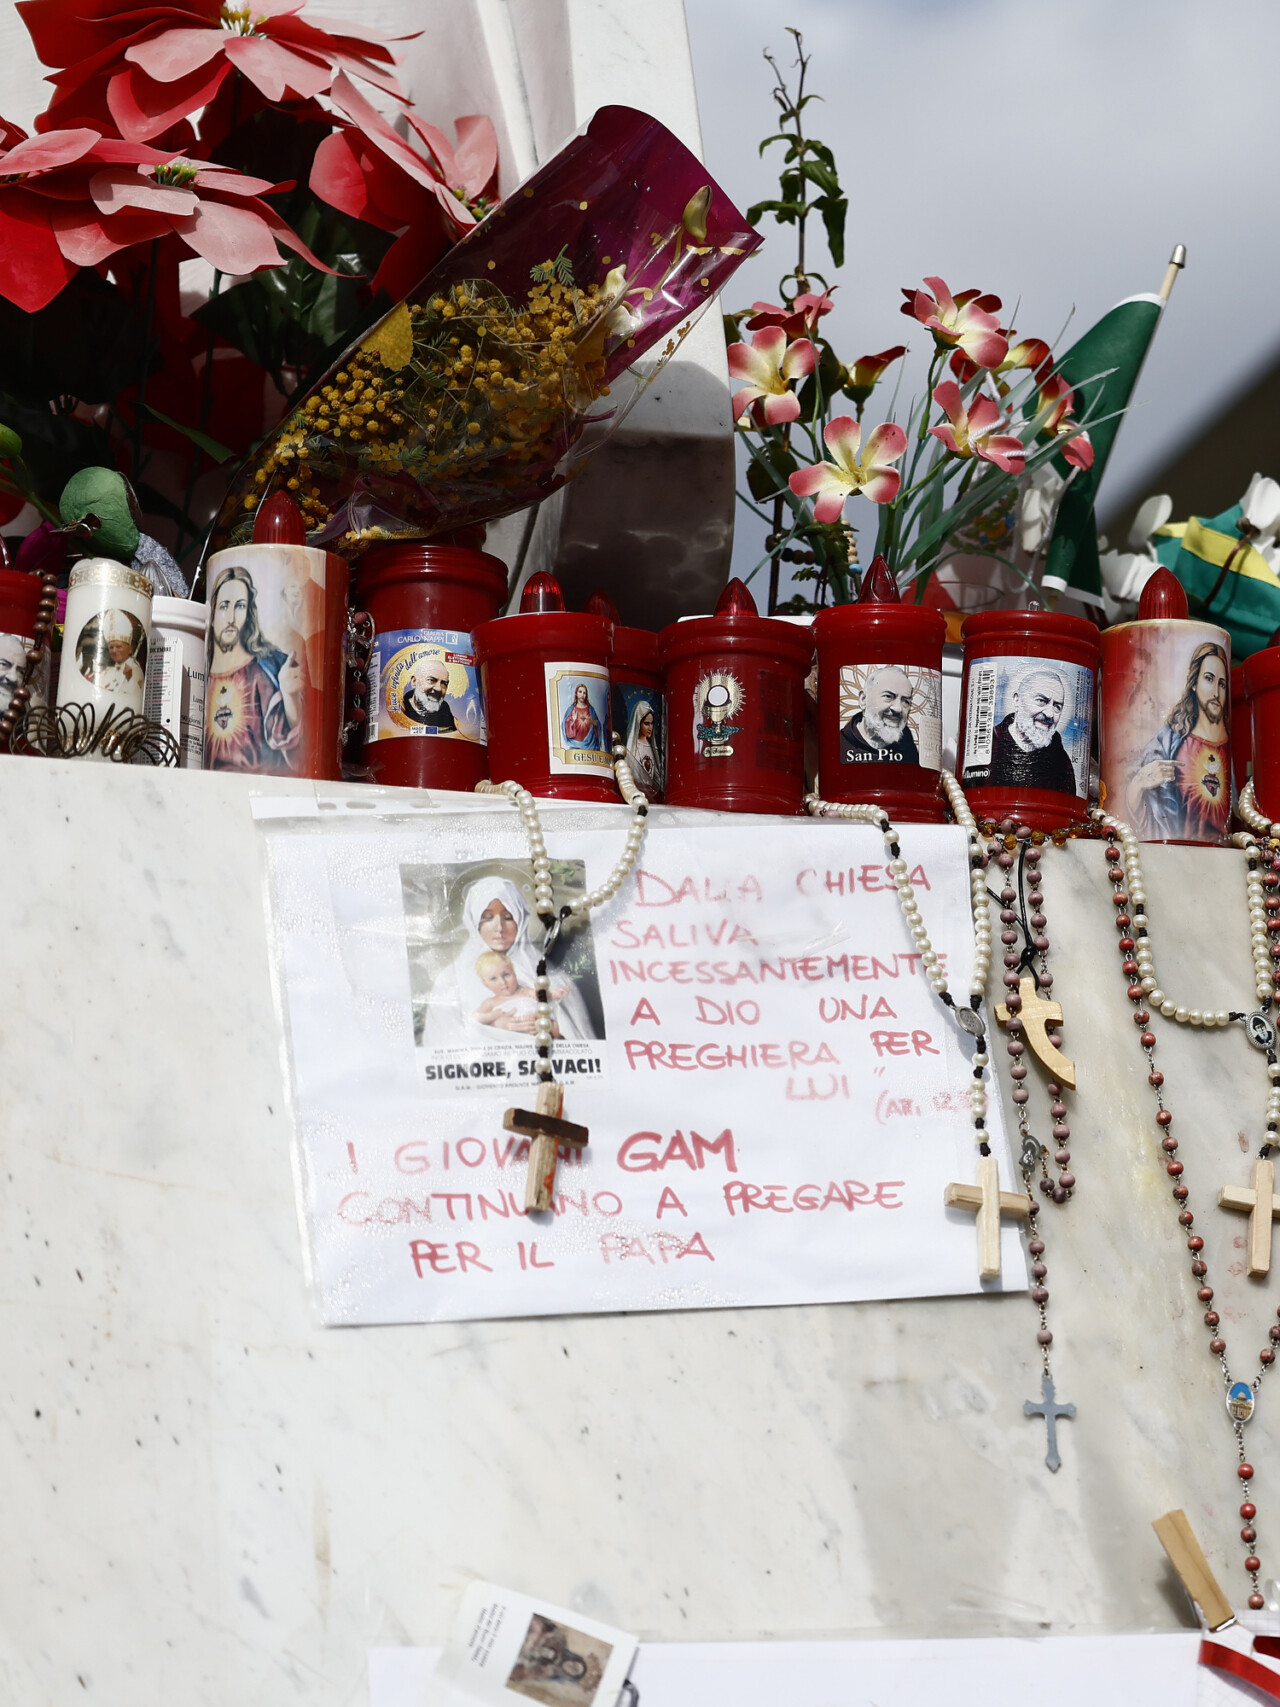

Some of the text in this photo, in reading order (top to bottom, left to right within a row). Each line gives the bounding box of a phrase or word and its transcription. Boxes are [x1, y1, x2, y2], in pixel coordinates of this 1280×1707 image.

[397, 636, 421, 644] CARLO
[846, 748, 903, 762] San Pio
[796, 864, 931, 898] CHIESA
[610, 918, 760, 949] SALIVA
[630, 993, 898, 1026] A DIO UNA
[624, 1029, 940, 1071] PREGHIERA PER
[425, 1061, 511, 1081] SIGNORE,
[347, 1141, 358, 1174] I
[617, 1128, 738, 1173] GAM
[656, 1186, 688, 1219] A
[723, 1180, 905, 1216] PREGARE
[409, 1231, 716, 1279] PER IL PAPA
